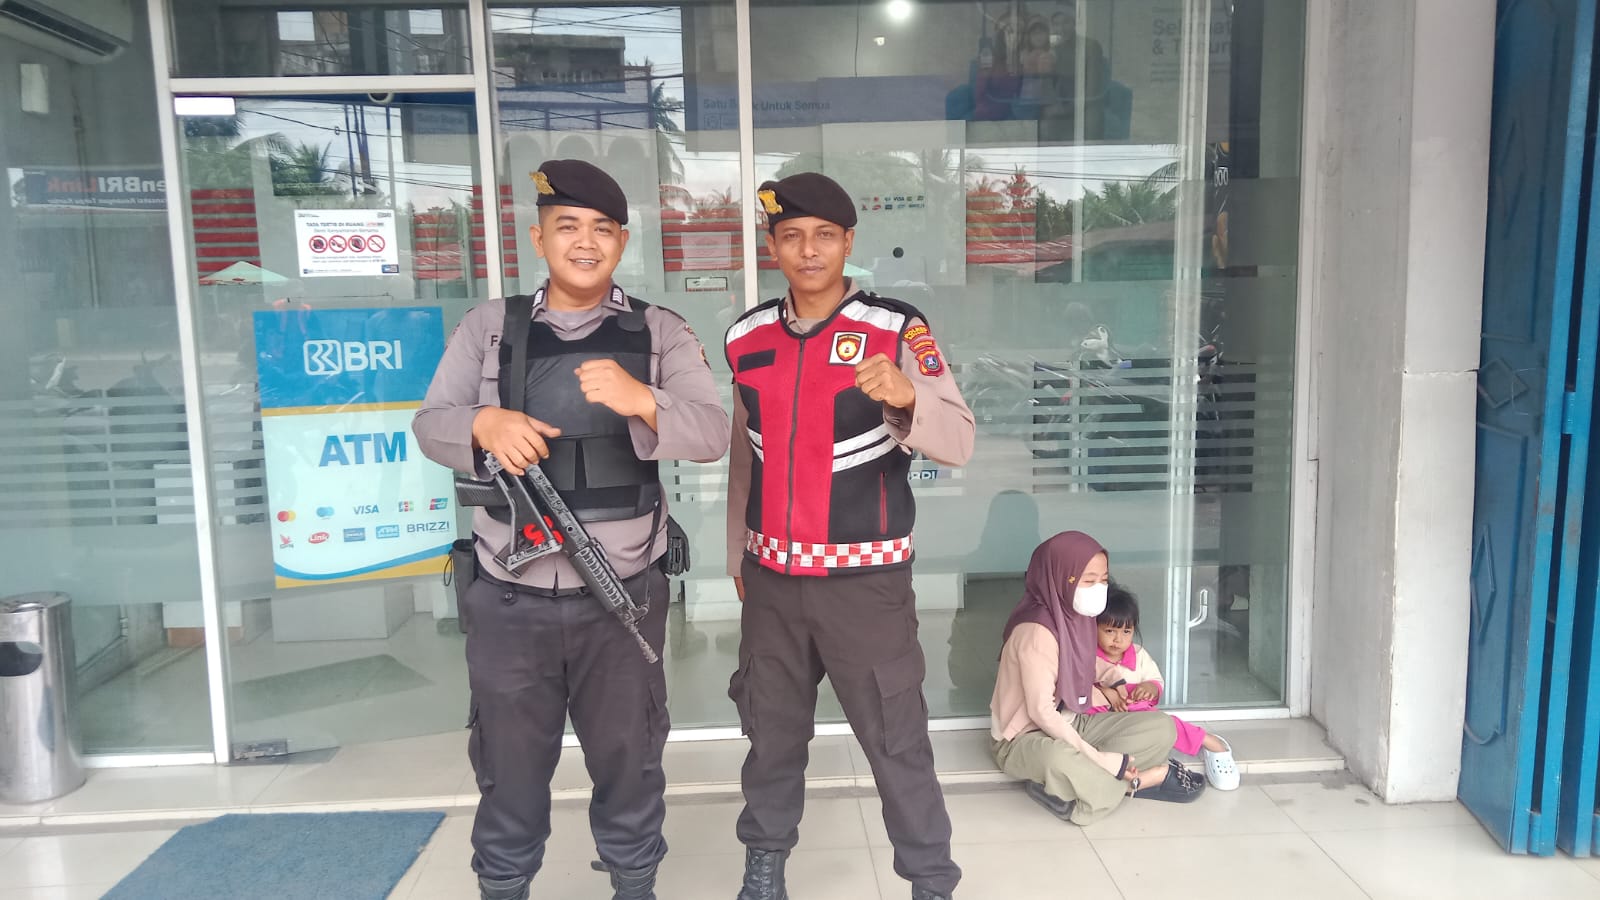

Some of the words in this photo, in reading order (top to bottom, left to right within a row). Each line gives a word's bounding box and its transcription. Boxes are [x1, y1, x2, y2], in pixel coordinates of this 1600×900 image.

[761, 100, 792, 111] Untuk
[344, 340, 403, 371] BRI
[319, 431, 407, 467] ATM
[354, 504, 379, 515] VISA
[407, 521, 450, 533] BRIZZI
[309, 533, 328, 542] Link
